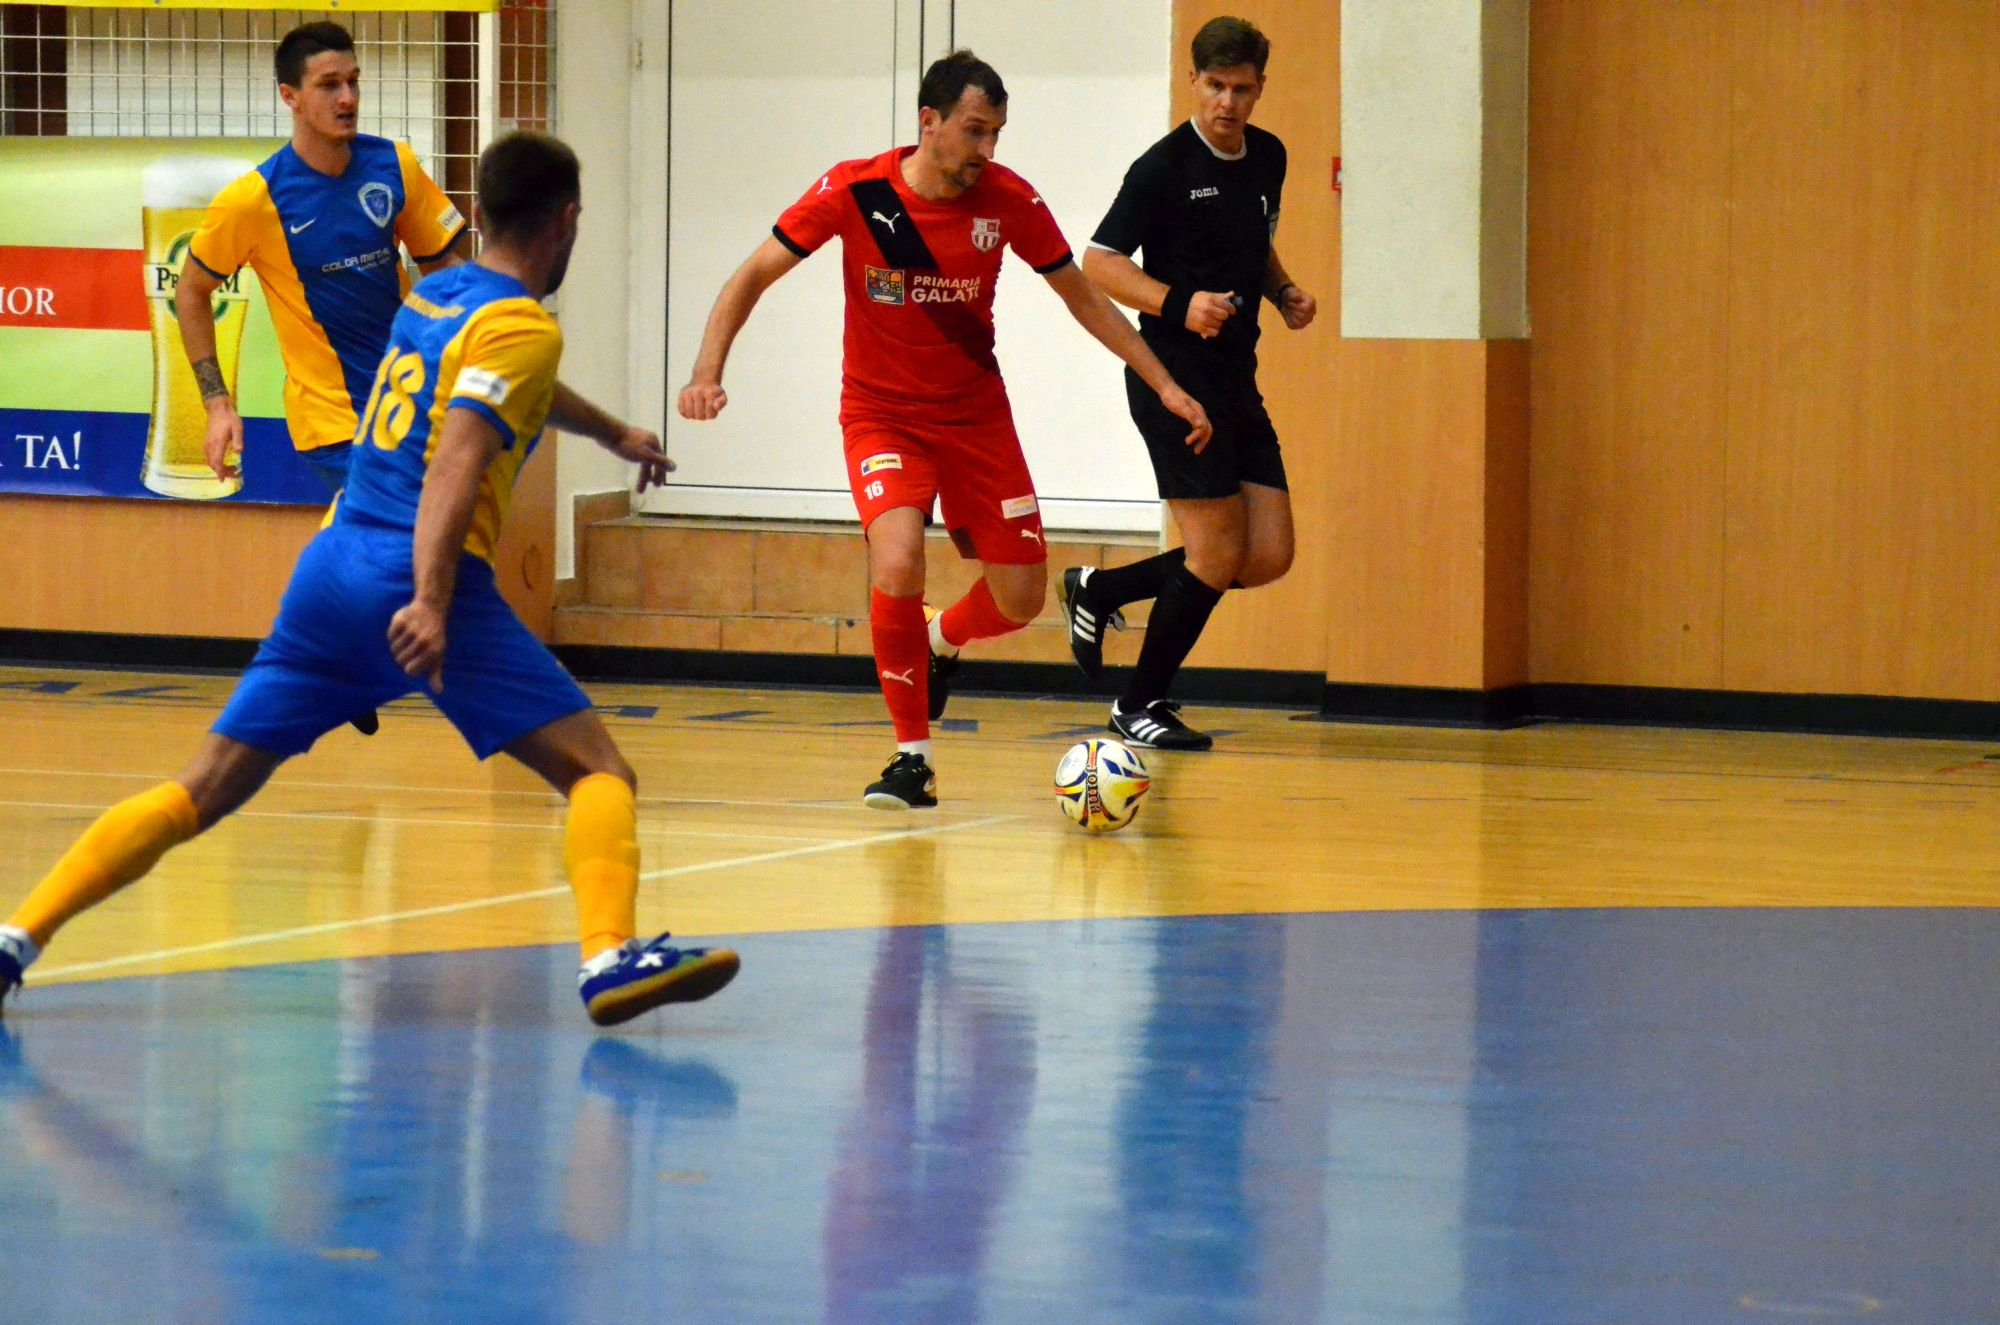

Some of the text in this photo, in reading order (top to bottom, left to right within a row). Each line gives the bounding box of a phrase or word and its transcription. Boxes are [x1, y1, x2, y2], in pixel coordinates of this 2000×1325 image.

[322, 256, 359, 272] COLOR
[913, 275, 981, 289] PRIMARIA
[353, 346, 426, 451] 18
[16, 431, 81, 470] TA!
[864, 480, 885, 501] 16
